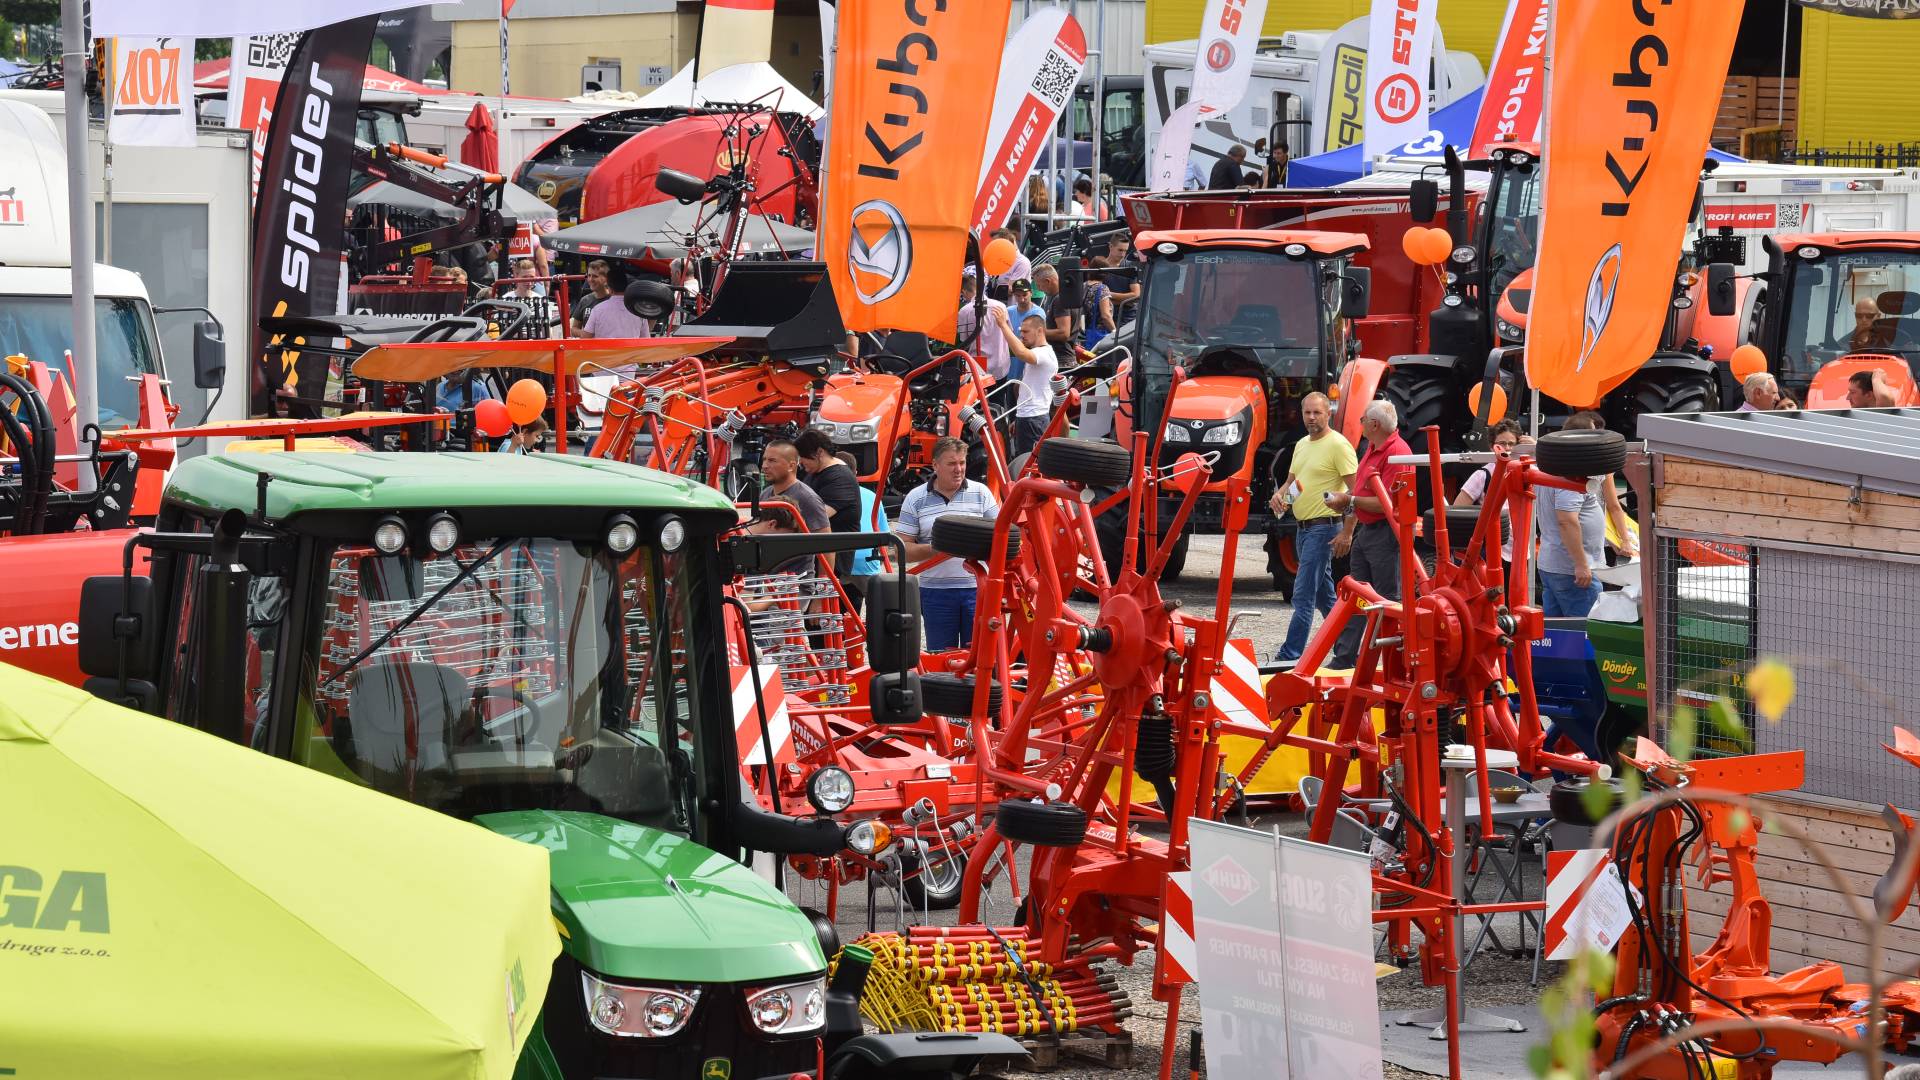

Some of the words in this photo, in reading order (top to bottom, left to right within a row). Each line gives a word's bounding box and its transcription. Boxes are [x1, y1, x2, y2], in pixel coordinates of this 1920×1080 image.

[649, 66, 662, 74] WC
[1337, 54, 1364, 149] quali
[1005, 108, 1040, 174] KMET
[281, 62, 334, 294] spider
[1738, 212, 1773, 221] KMET
[1602, 659, 1637, 676] Dönder
[60, 946, 111, 957] z.o.o.
